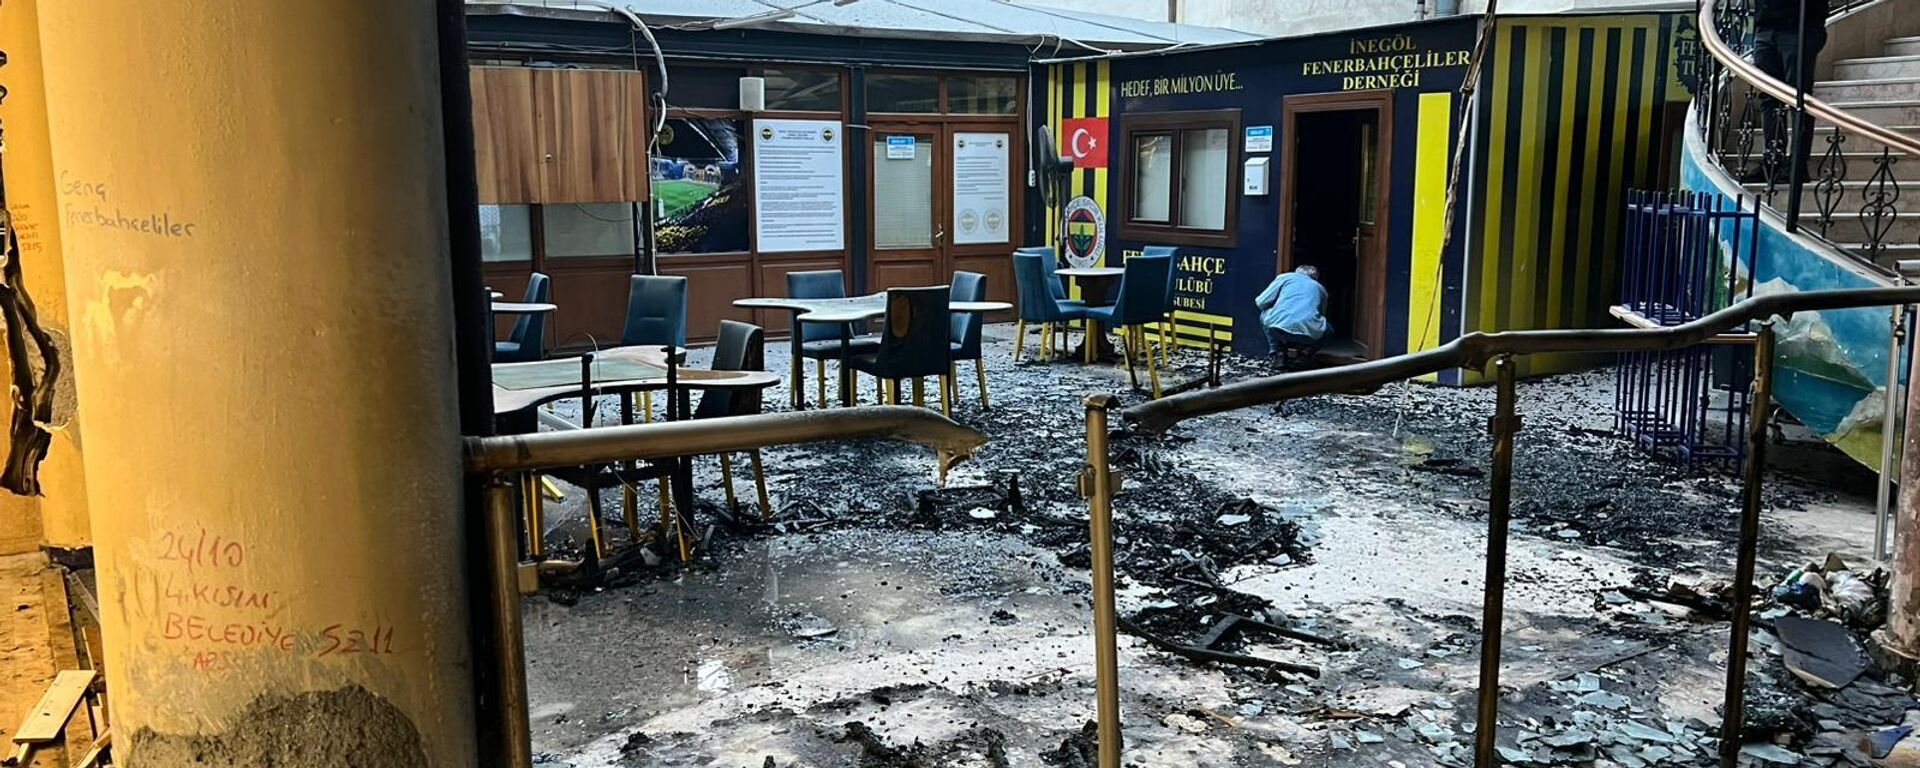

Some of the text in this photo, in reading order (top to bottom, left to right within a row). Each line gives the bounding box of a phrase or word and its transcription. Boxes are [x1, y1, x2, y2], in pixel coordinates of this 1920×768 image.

[1350, 34, 1416, 54] İNEGÖL
[1303, 50, 1471, 76] FENERBAHÇELİLER
[1121, 80, 1152, 97] HEDEF,
[1154, 75, 1169, 95] BİR
[1170, 74, 1213, 94] MİLYON
[1343, 69, 1420, 90] DERNEĞİ
[157, 529, 244, 573] 24/10
